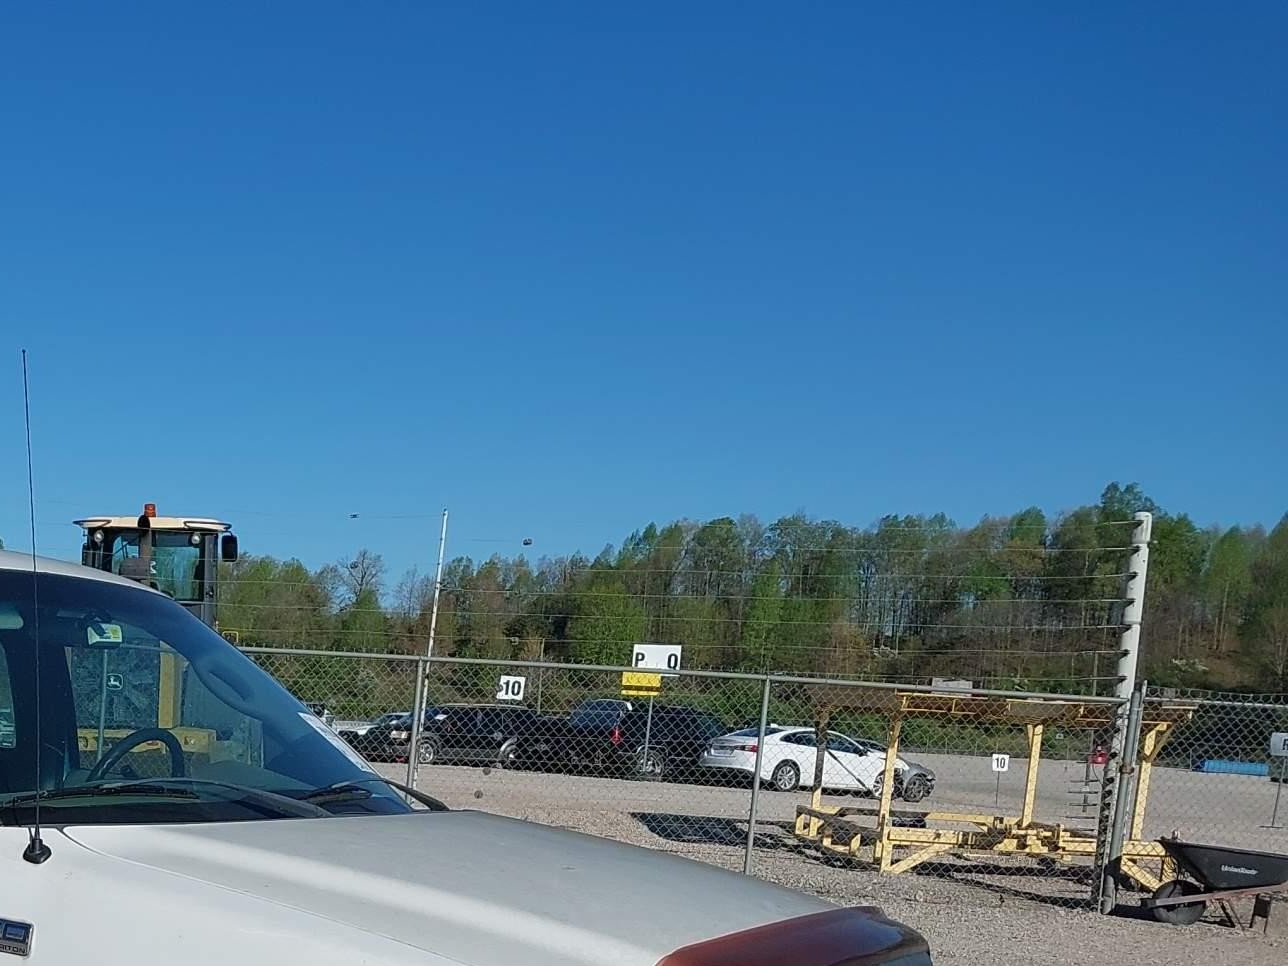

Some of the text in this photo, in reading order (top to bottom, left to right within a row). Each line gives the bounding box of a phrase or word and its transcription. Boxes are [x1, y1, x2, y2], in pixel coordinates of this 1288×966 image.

[634, 652, 645, 667] P
[503, 680, 521, 696] 10
[995, 757, 1006, 768] 10
